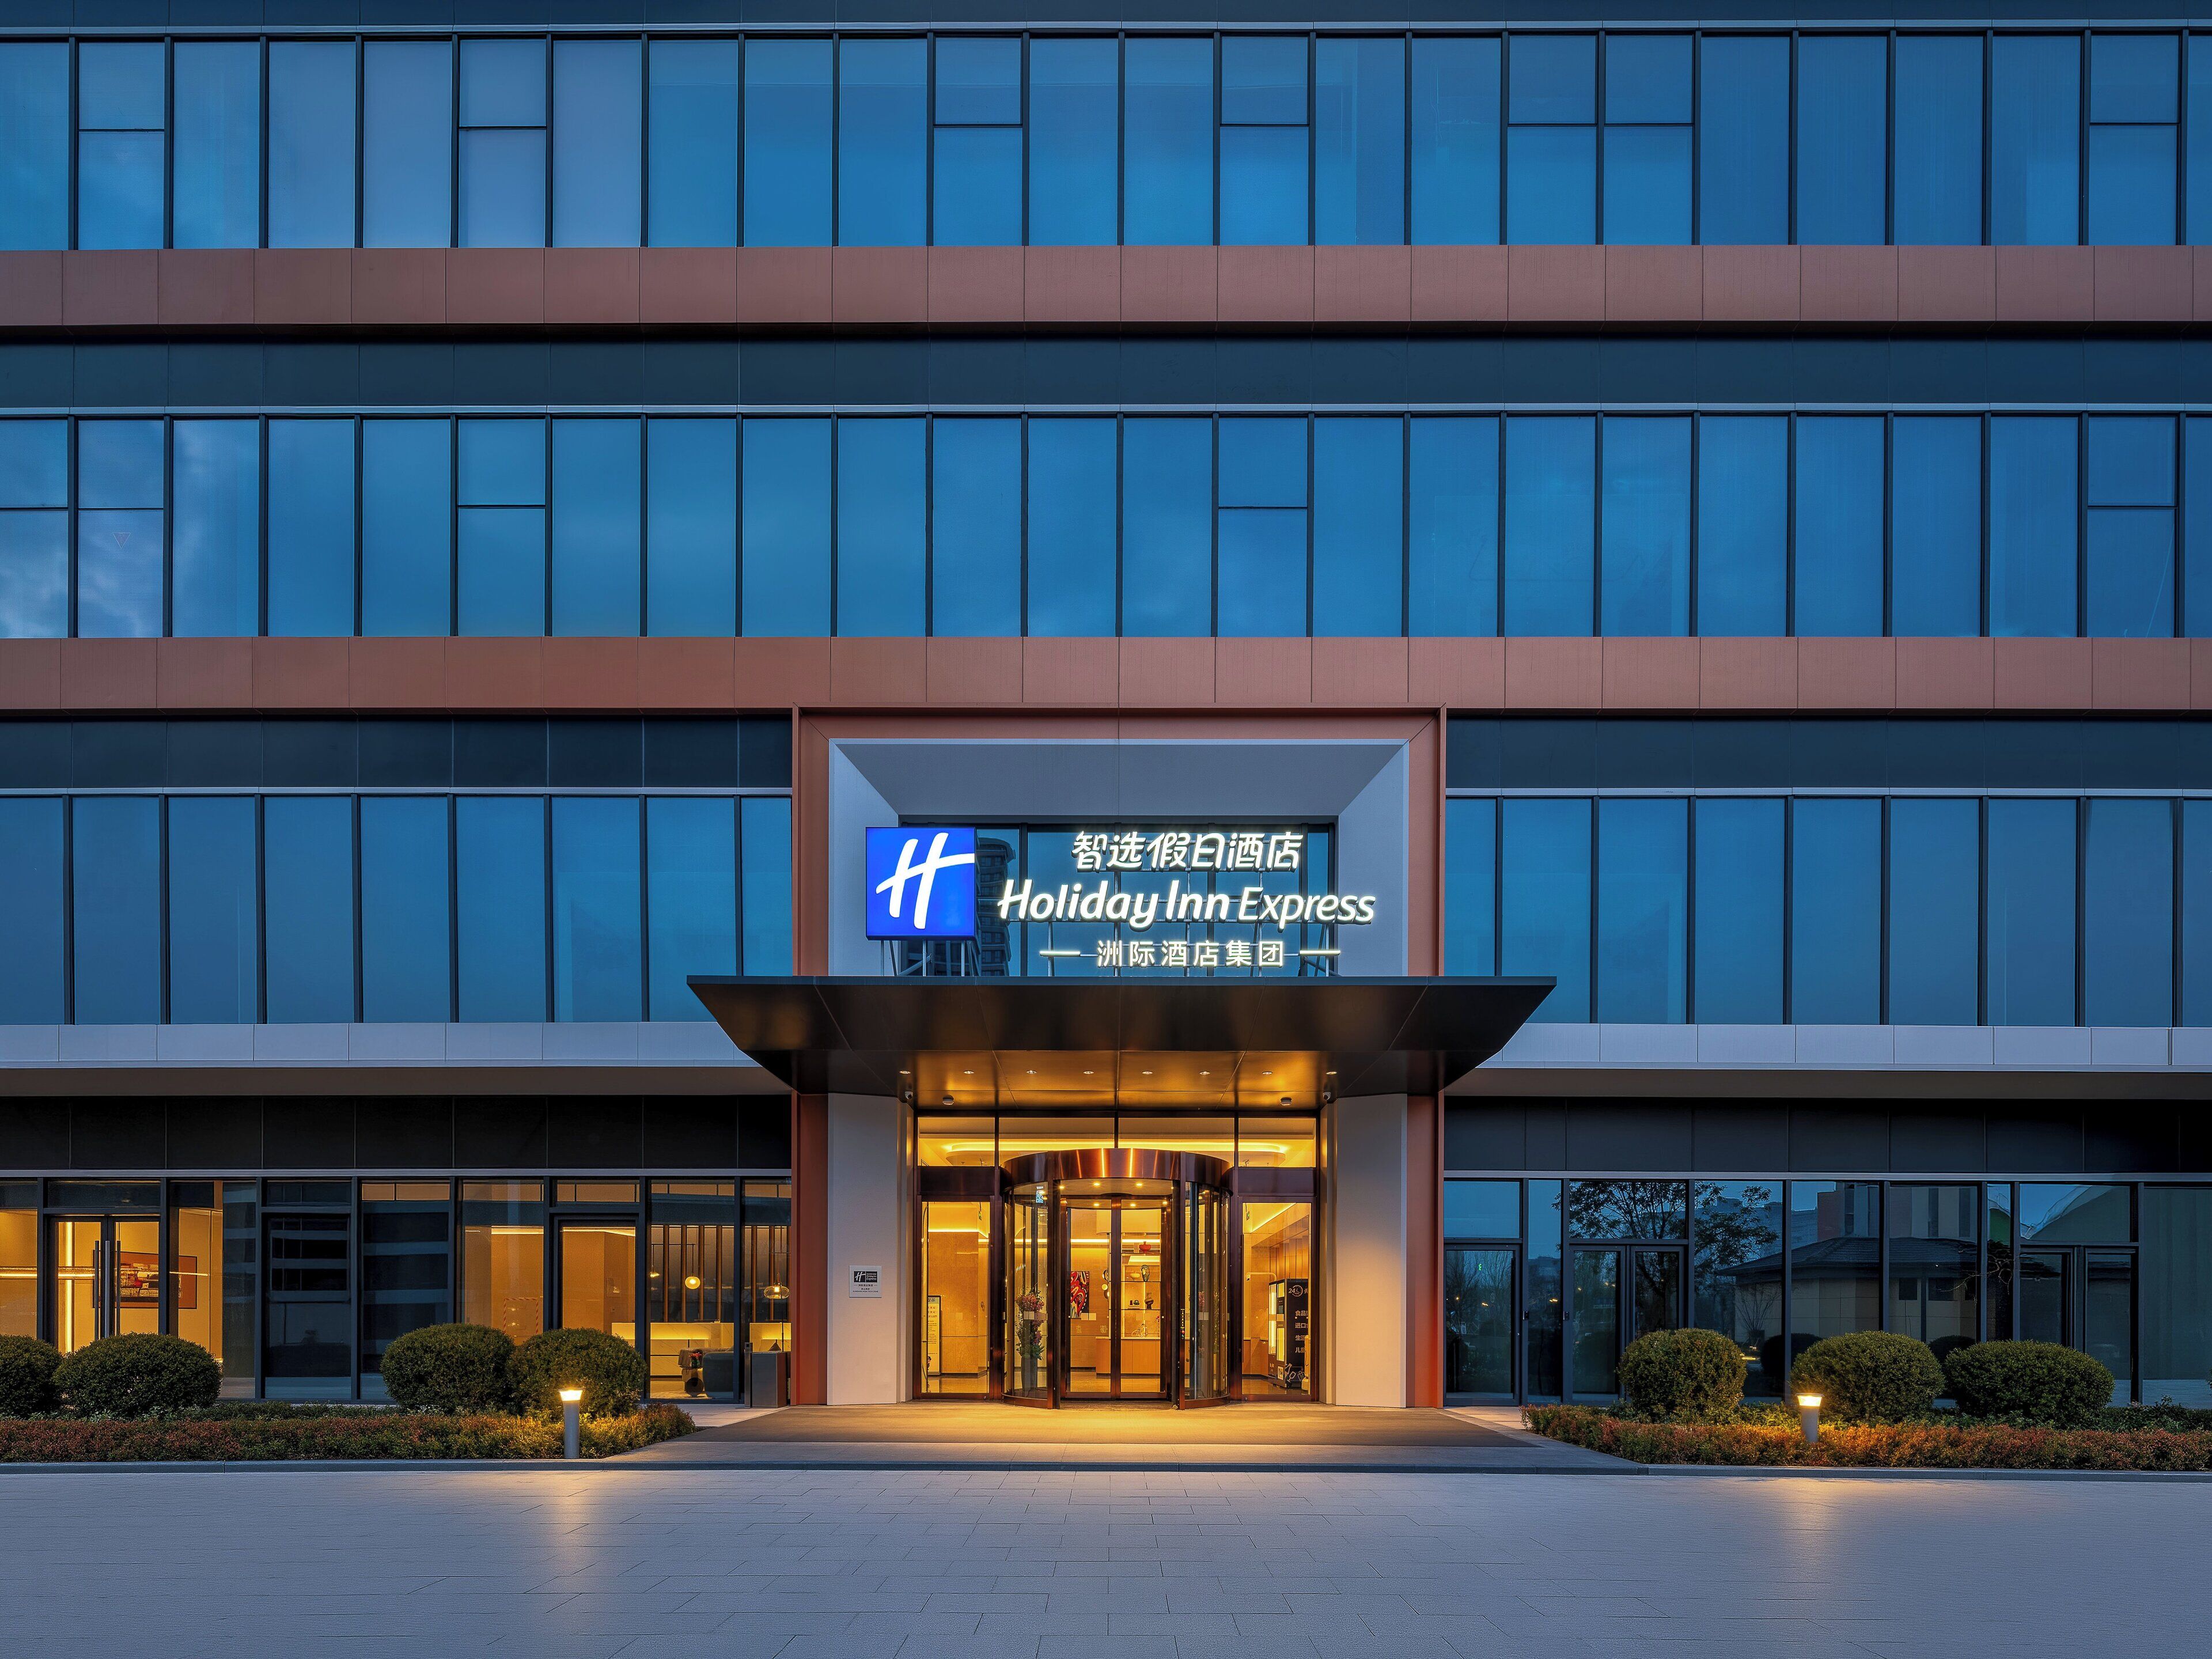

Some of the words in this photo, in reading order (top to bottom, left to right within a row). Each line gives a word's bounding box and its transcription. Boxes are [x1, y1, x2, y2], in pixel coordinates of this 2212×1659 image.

[1072, 831, 1304, 871] 智选假日酒店
[997, 879, 1159, 930] Holiday
[1165, 880, 1230, 921] Inn
[1238, 887, 1376, 933] Express
[1097, 940, 1285, 967] 洲际酒店集团
